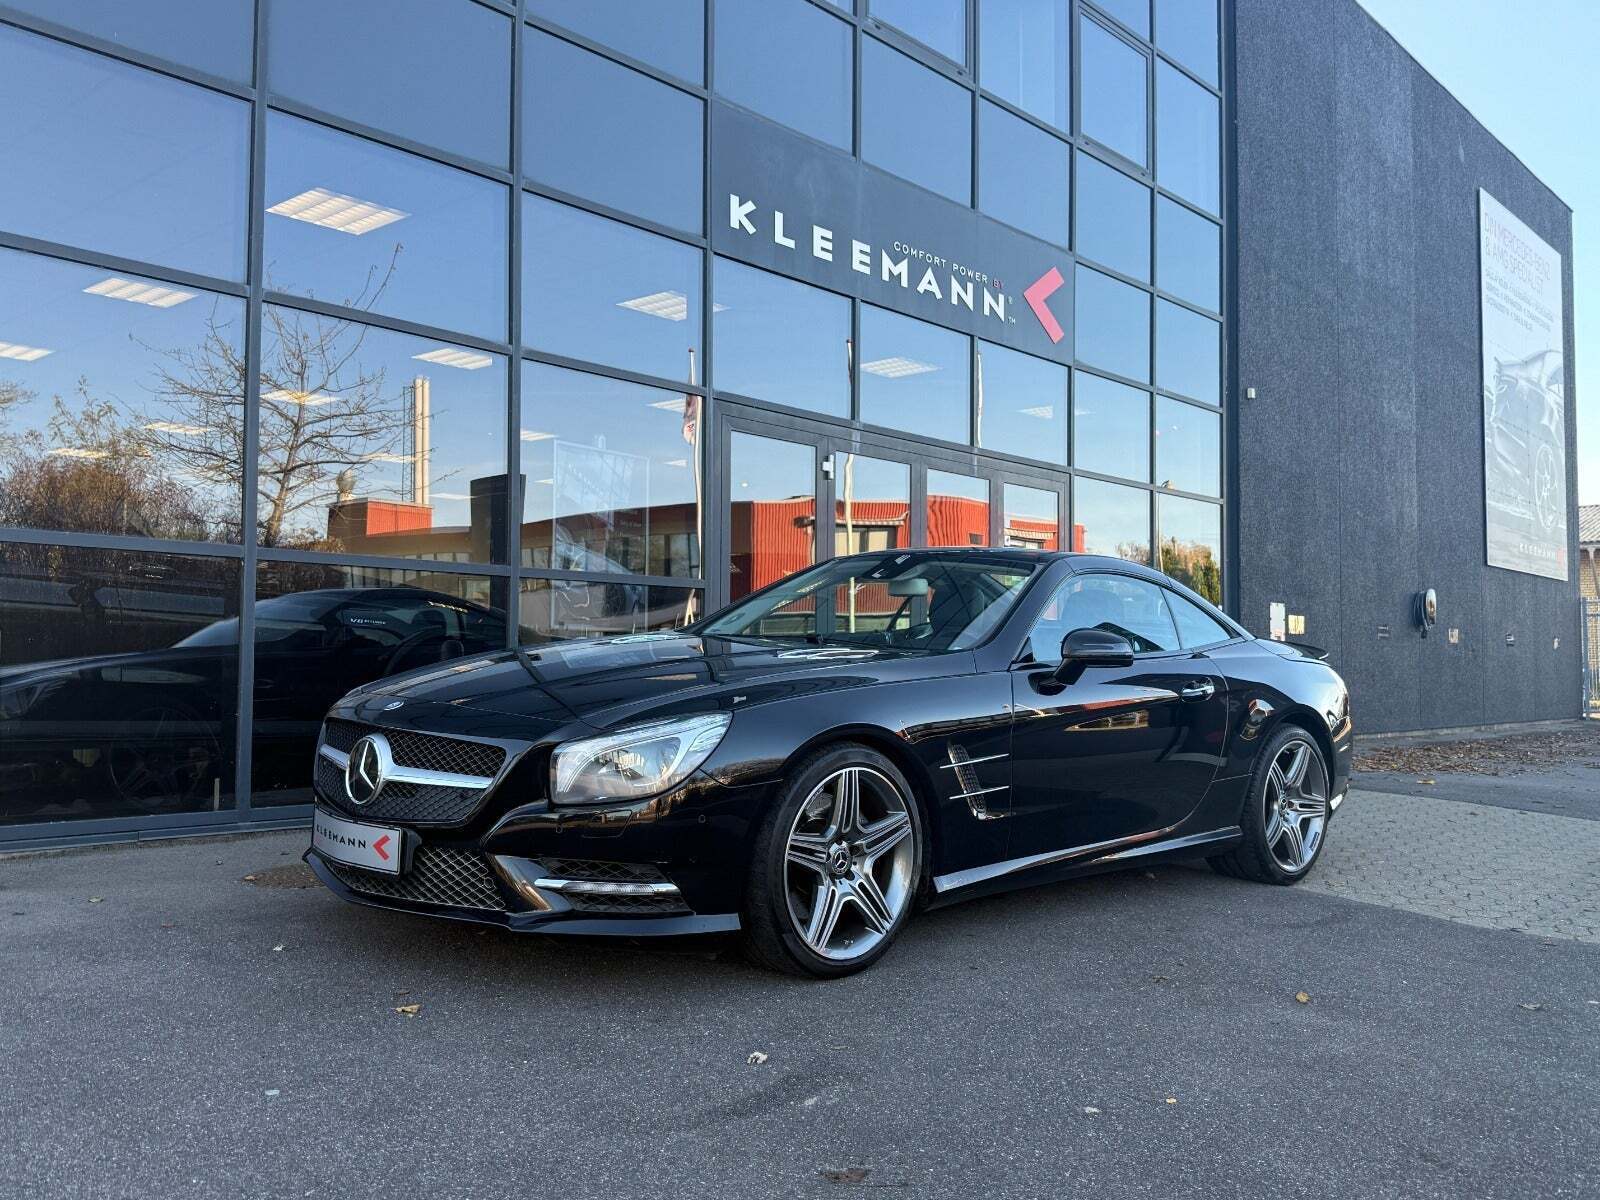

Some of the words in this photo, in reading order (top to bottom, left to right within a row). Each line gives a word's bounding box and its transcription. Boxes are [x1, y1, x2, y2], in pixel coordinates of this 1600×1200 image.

[729, 193, 1005, 322] KLEEMANN
[893, 240, 947, 269] COMFORT
[952, 263, 988, 284] POWER
[316, 823, 367, 850] KLEEMANN
